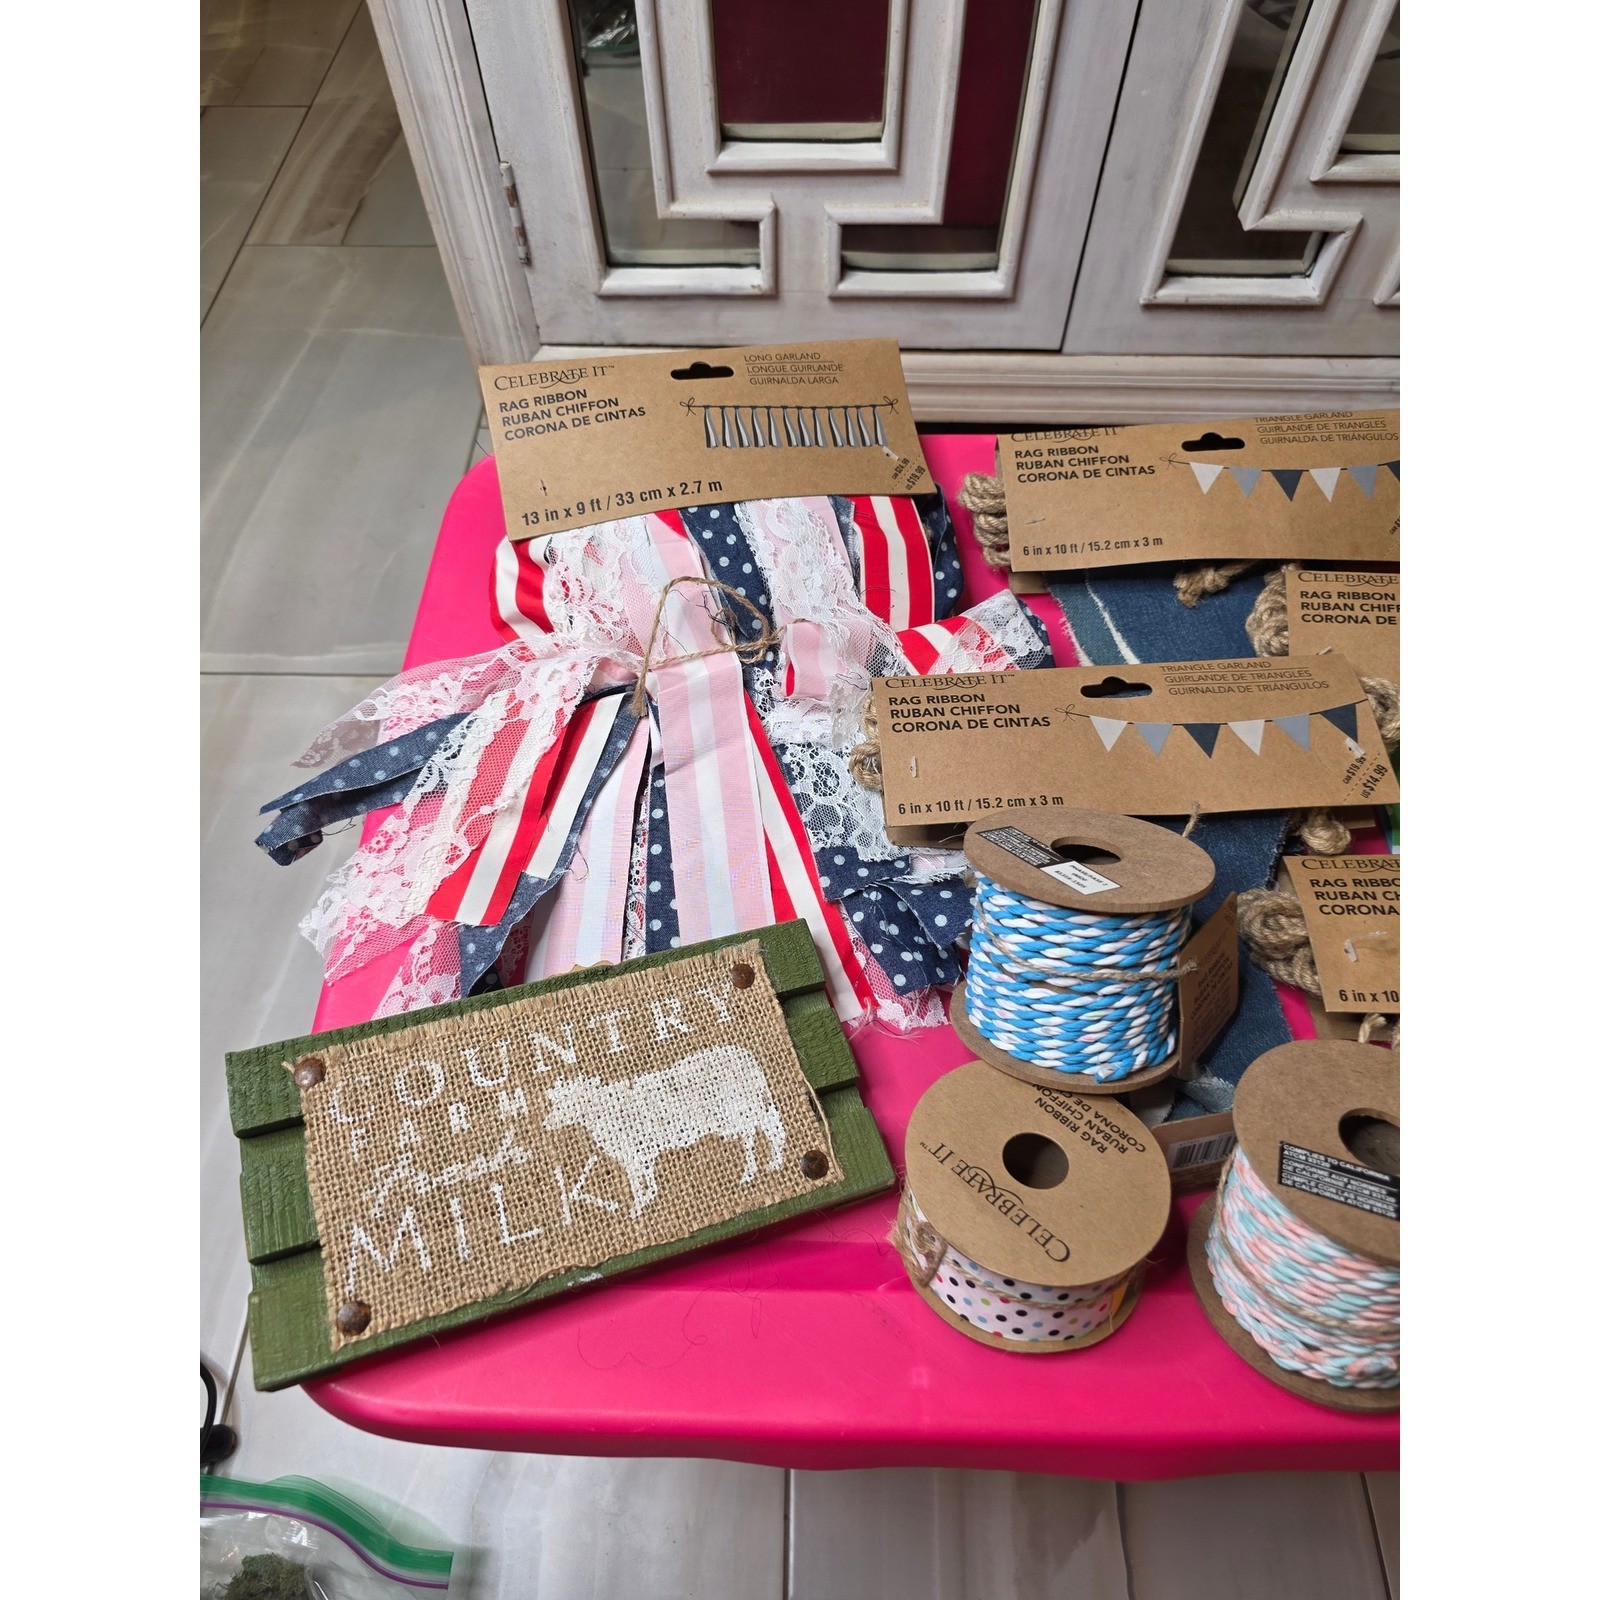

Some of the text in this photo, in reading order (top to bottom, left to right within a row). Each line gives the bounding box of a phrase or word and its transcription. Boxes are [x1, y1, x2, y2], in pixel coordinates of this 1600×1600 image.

[744, 352, 821, 363] LONG GARLAND
[746, 363, 844, 374] LONGUE GUIRLANDE
[494, 368, 588, 390] CELEBRATE
[749, 376, 839, 385] GUIRNALDA LARGA
[499, 388, 588, 413] RAG RIBBON
[502, 397, 619, 427] RUBAN CHIFFON
[1254, 411, 1353, 423] TRIANGLE GARLAND
[504, 406, 646, 441] CORONA DE CINTAS
[1257, 420, 1387, 434] GUIRLANDE DE TRIANGLES
[1011, 428, 1100, 443] CELEBRATE
[1260, 432, 1399, 445] GUIRNALDA DE TRIÁNGULOS
[1014, 445, 1099, 459] RAG RIBBON
[1016, 455, 1129, 470] RUBAN CHIFFON
[1017, 465, 1155, 483] CORONA DE CINTAS
[521, 511, 540, 526] 13
[544, 508, 559, 522] in
[564, 506, 573, 518] x
[576, 502, 585, 515] 9
[590, 498, 602, 513] ft
[615, 491, 635, 507] 33
[639, 487, 663, 501] cm
[666, 485, 676, 498] x
[680, 480, 702, 496] 2.7
[708, 480, 723, 492] m
[1023, 546, 1030, 556] 6
[1033, 545, 1043, 556] in
[1045, 546, 1052, 555] x
[1054, 544, 1067, 554] 10
[1070, 543, 1078, 553] ft
[1088, 540, 1111, 551] 15.2
[1114, 539, 1131, 549] cm
[1133, 538, 1140, 548] x
[1142, 536, 1150, 547] 3
[1152, 537, 1163, 546] m
[1298, 572, 1399, 587] CELEBRATE
[1300, 590, 1396, 601] RAG RIBBON
[1301, 602, 1355, 612] RUBAN
[1301, 614, 1397, 625] CORONA DE
[1160, 661, 1272, 673] TRIANGLE GARLAND
[885, 675, 987, 690] CELEBRATE
[1164, 670, 1312, 684] GUIRLANDE DE TRIANGLES
[1168, 680, 1330, 696] GUIRNALDA DE TRIÁNGULOS
[889, 693, 986, 706] RAG RIBBON
[890, 704, 1021, 719] RUBAN CHIFFON
[891, 716, 1051, 733] CORONA DE CINTAS
[1362, 764, 1389, 792] $14.99
[898, 803, 906, 815] 6
[910, 803, 922, 814] in
[925, 803, 933, 813] x
[936, 800, 950, 812] 10
[954, 799, 964, 811] ft
[975, 797, 1003, 809] 15.2
[1007, 797, 1026, 807] cm
[1030, 797, 1037, 806] x
[1040, 795, 1048, 806] 3
[1052, 796, 1064, 805] m
[1309, 878, 1347, 888] RAG
[1315, 891, 1377, 901] RUBAN
[1319, 904, 1400, 916] CORONA
[1339, 989, 1400, 1003] 6 in x 10
[328, 978, 733, 1124] COUNTRY
[351, 1087, 529, 1161] FARM
[1033, 1083, 1129, 1154] RUBAN CHIFFON
[1034, 1097, 1108, 1154] RAG RIBBON
[1073, 1098, 1147, 1153] CORONA DE
[1283, 1150, 1331, 1168] ATCM 93120
[1283, 1144, 1390, 1181] COMPLIES TO CALIFORNIA
[1283, 1159, 1387, 1195] CONFORME AUX NORMES
[1295, 1168, 1345, 1188] CALIFORNIE
[1346, 1184, 1370, 1195] ATCM
[1281, 1178, 1293, 1186] DE
[1295, 1181, 1345, 1202] CALIFORNIA
[1346, 1198, 1370, 1210] ATCM
[1282, 1172, 1395, 1212] CUMPLE CON LAS NORMAS
[951, 1159, 1071, 1263] CELEBRATE
[344, 1155, 620, 1295] MILK
